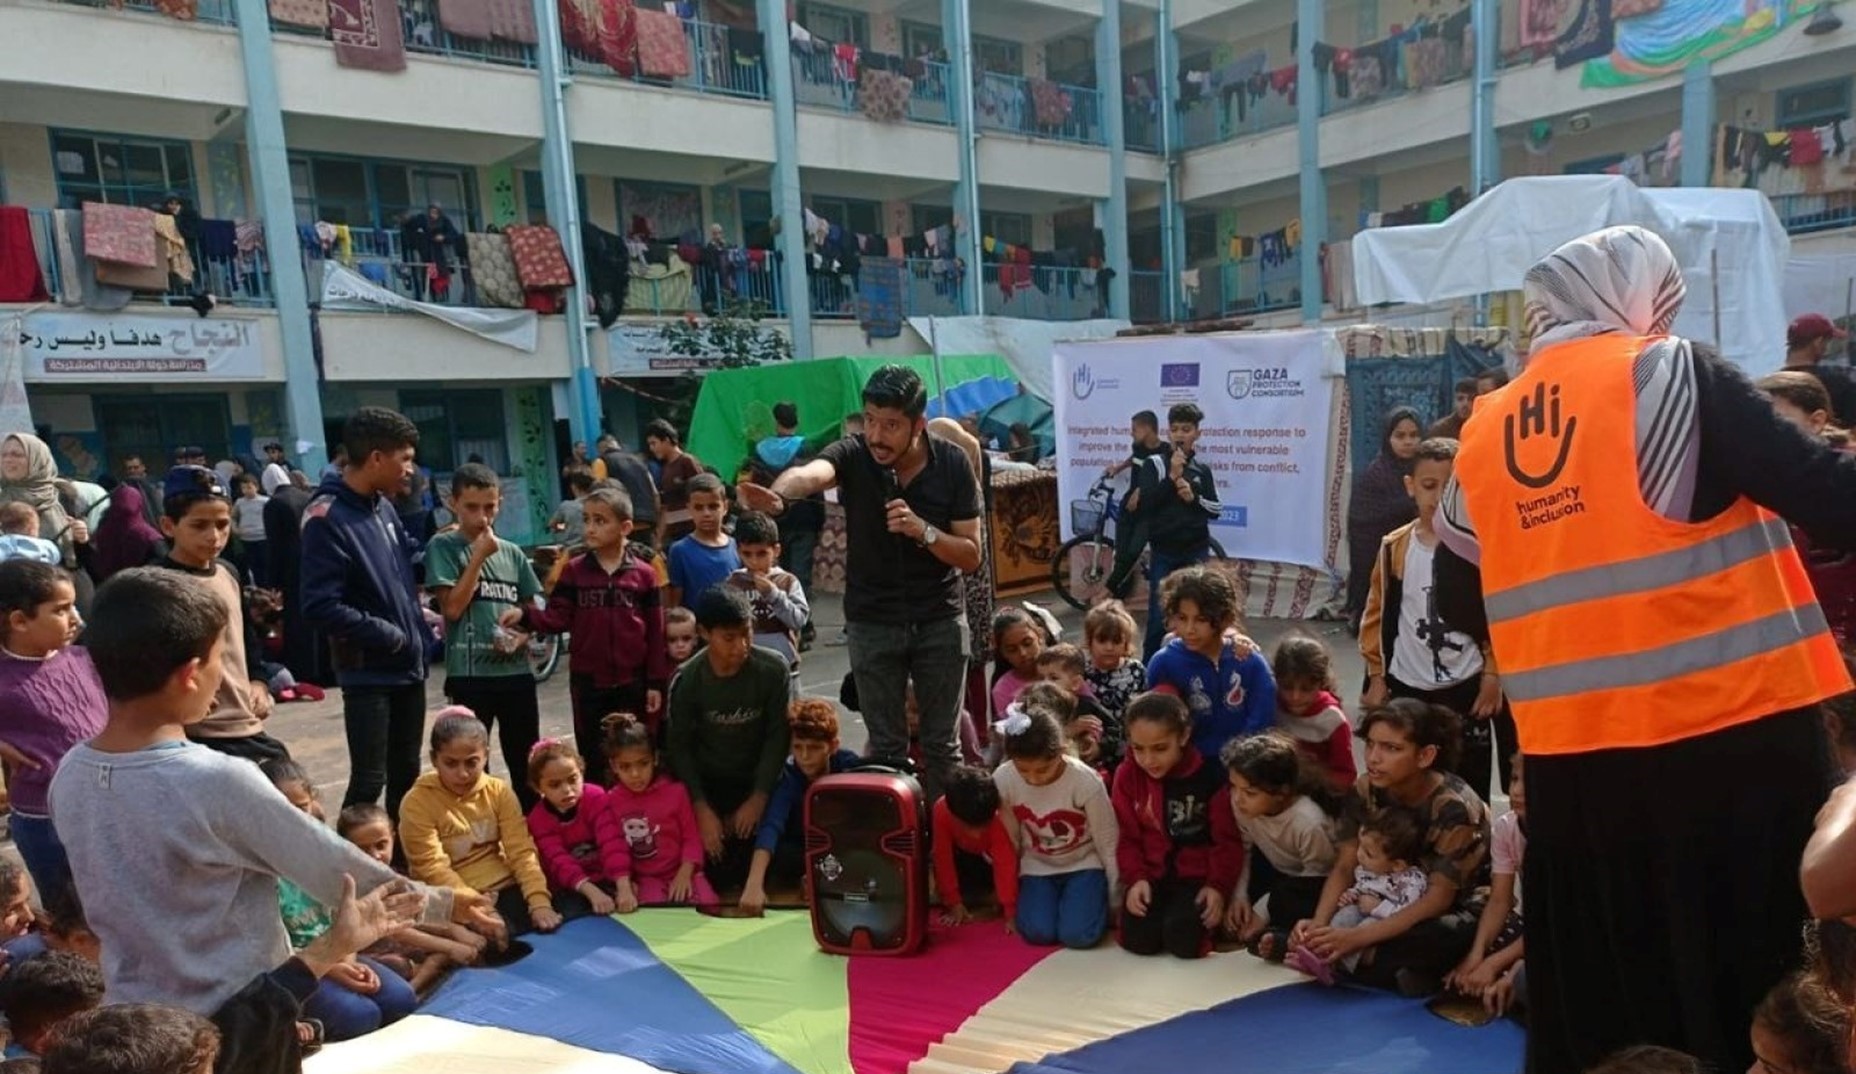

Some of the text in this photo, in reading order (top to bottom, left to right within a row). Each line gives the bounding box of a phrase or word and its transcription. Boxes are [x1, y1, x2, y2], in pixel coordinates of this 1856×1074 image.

[48, 329, 106, 350] وليس
[169, 320, 250, 355] النجاح
[1253, 368, 1288, 380] GAZA
[1252, 380, 1300, 389] PROTECTION
[1251, 389, 1304, 397] CONSORTIUM
[1520, 381, 1561, 440] Hi
[1067, 425, 1109, 437] Integrated
[1199, 427, 1306, 439] rotection response to
[1078, 442, 1128, 453] improve the
[1209, 445, 1233, 454] most
[1235, 444, 1289, 455] vulnerable
[1210, 462, 1229, 471] isks
[1232, 462, 1255, 472] from
[1516, 485, 1580, 514] humanity
[1522, 501, 1585, 530] &inclusion
[475, 581, 518, 602] RATING
